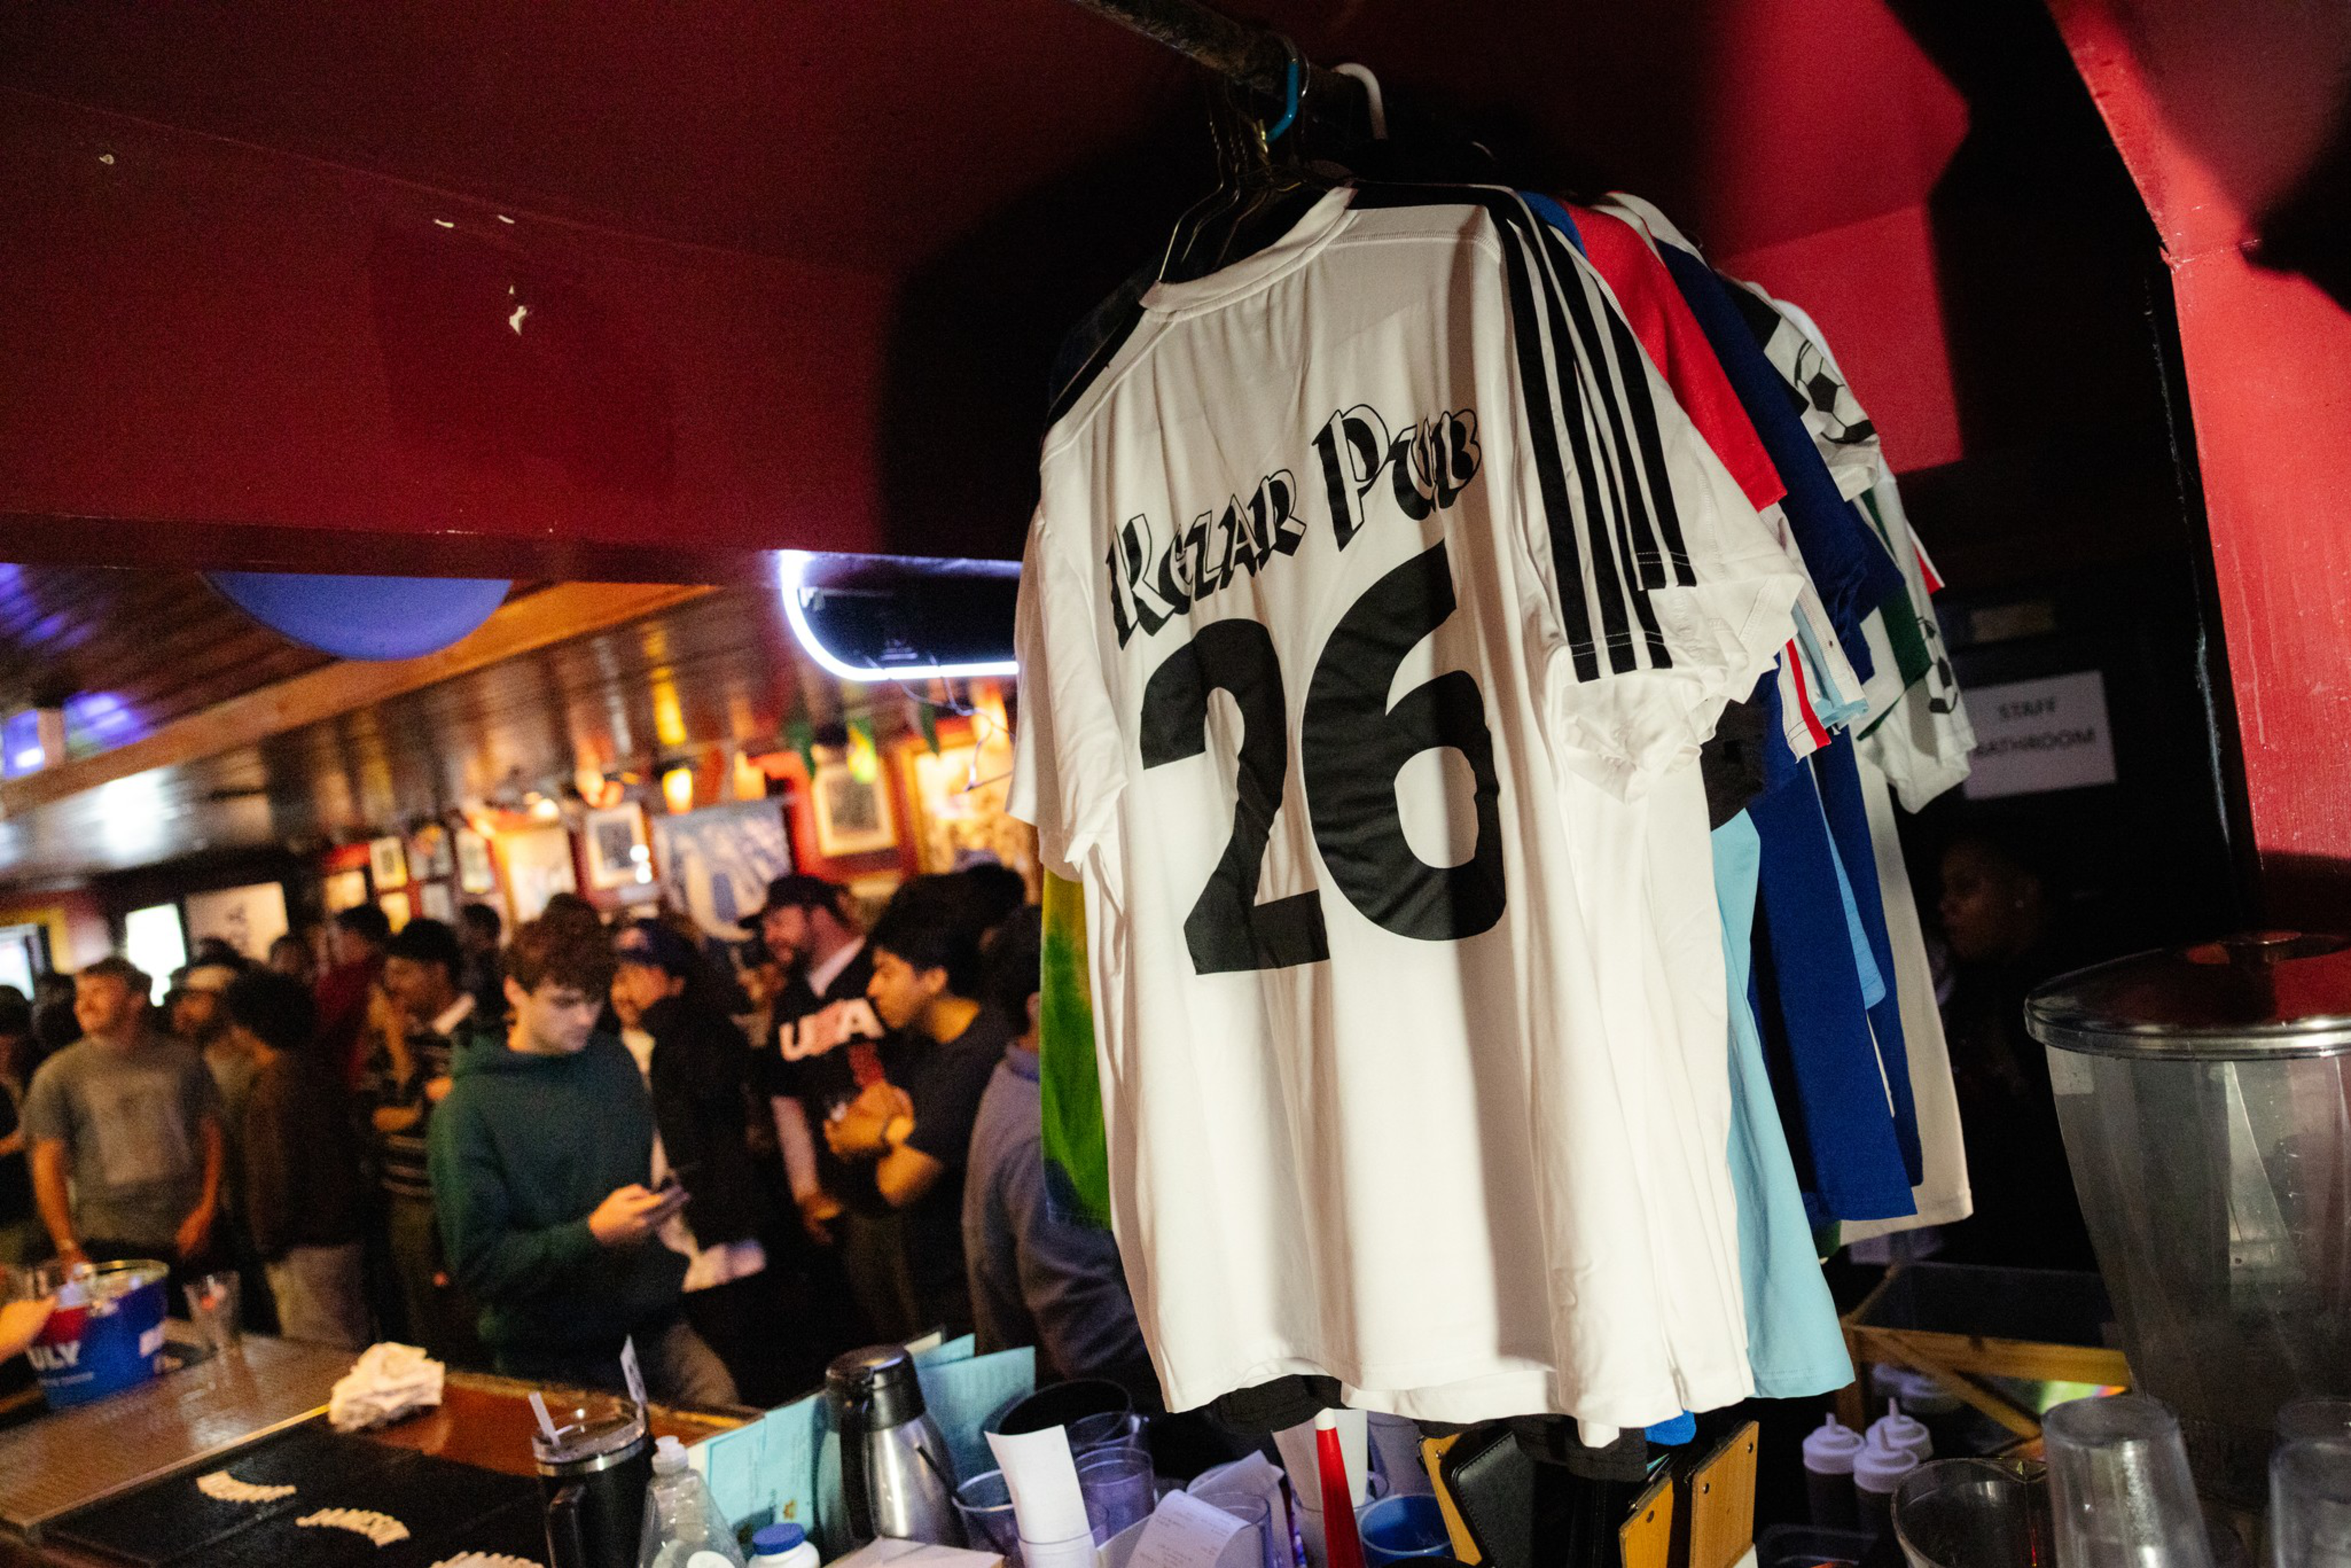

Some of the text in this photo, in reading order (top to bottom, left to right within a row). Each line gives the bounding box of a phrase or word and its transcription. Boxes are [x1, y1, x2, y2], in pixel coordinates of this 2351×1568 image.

[1311, 403, 1482, 552] PUB
[1140, 538, 1507, 975] 26
[27, 1341, 80, 1370] ULY
